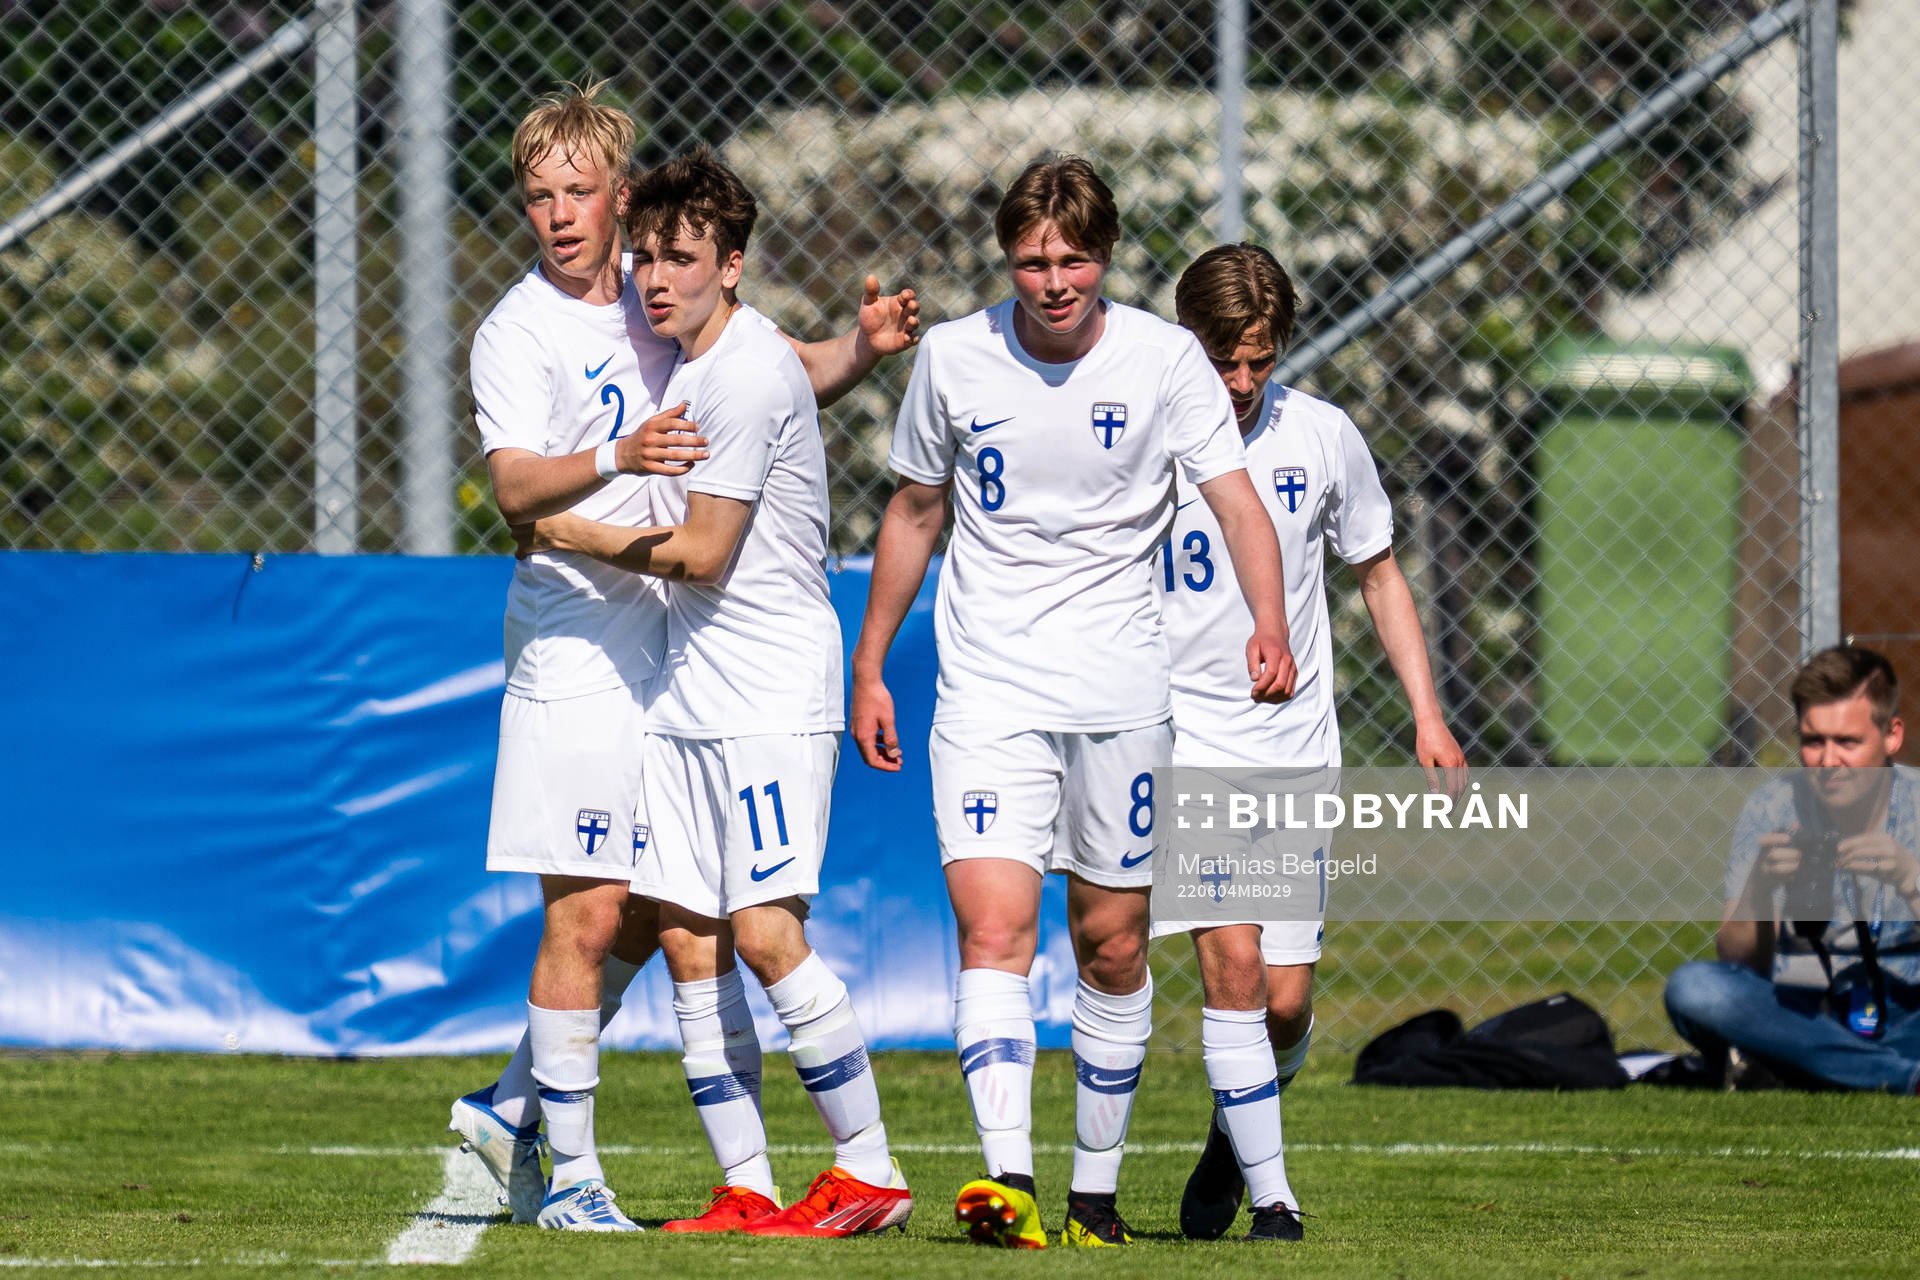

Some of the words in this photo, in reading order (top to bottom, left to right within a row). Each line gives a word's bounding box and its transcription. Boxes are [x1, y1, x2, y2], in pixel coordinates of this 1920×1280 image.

[601, 384, 629, 441] 2
[977, 447, 1005, 511] 8
[1162, 530, 1215, 593] 13
[738, 780, 790, 851] 11
[1130, 772, 1156, 838] 8
